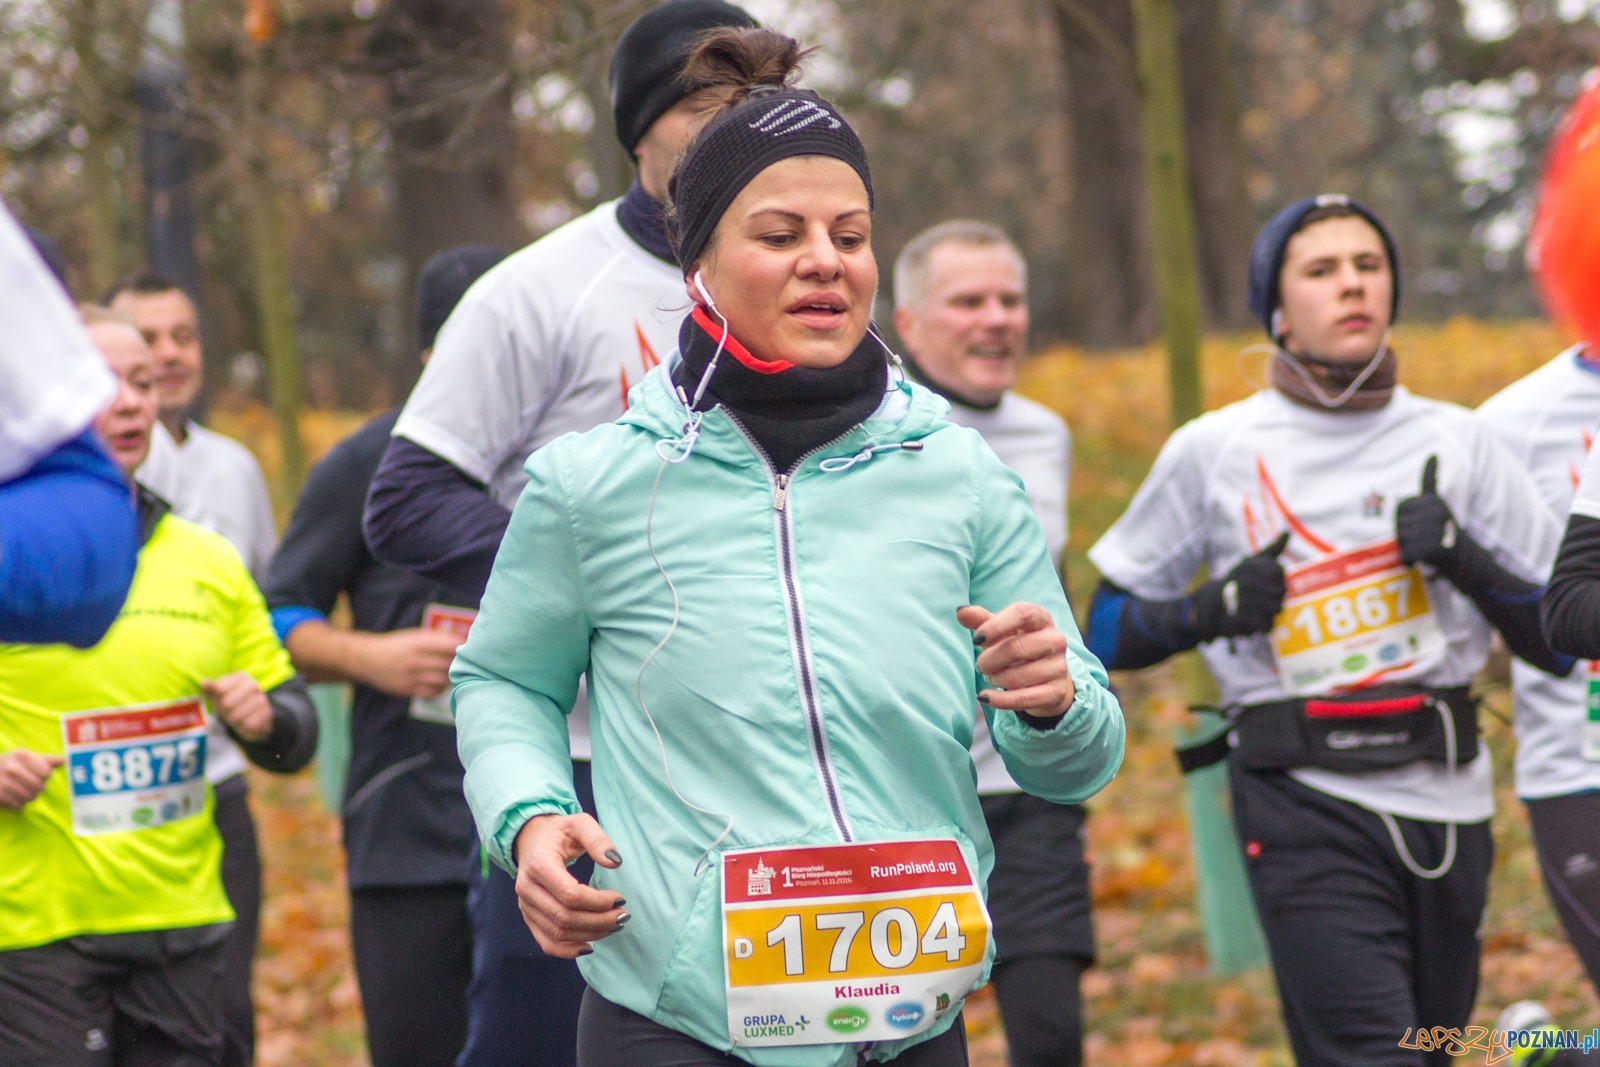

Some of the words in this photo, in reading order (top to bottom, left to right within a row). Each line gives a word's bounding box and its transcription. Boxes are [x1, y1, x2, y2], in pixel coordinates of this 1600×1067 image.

[1293, 576, 1411, 645] 1867
[91, 742, 198, 790] 8875
[781, 867, 793, 886] 1
[870, 860, 957, 878] RunPoland.org
[734, 938, 753, 959] D
[766, 902, 966, 976] 1704
[835, 983, 900, 998] Klaudia
[744, 1015, 786, 1026] GRUPA
[833, 1016, 865, 1028] energy
[744, 1026, 794, 1037] LUXMED
